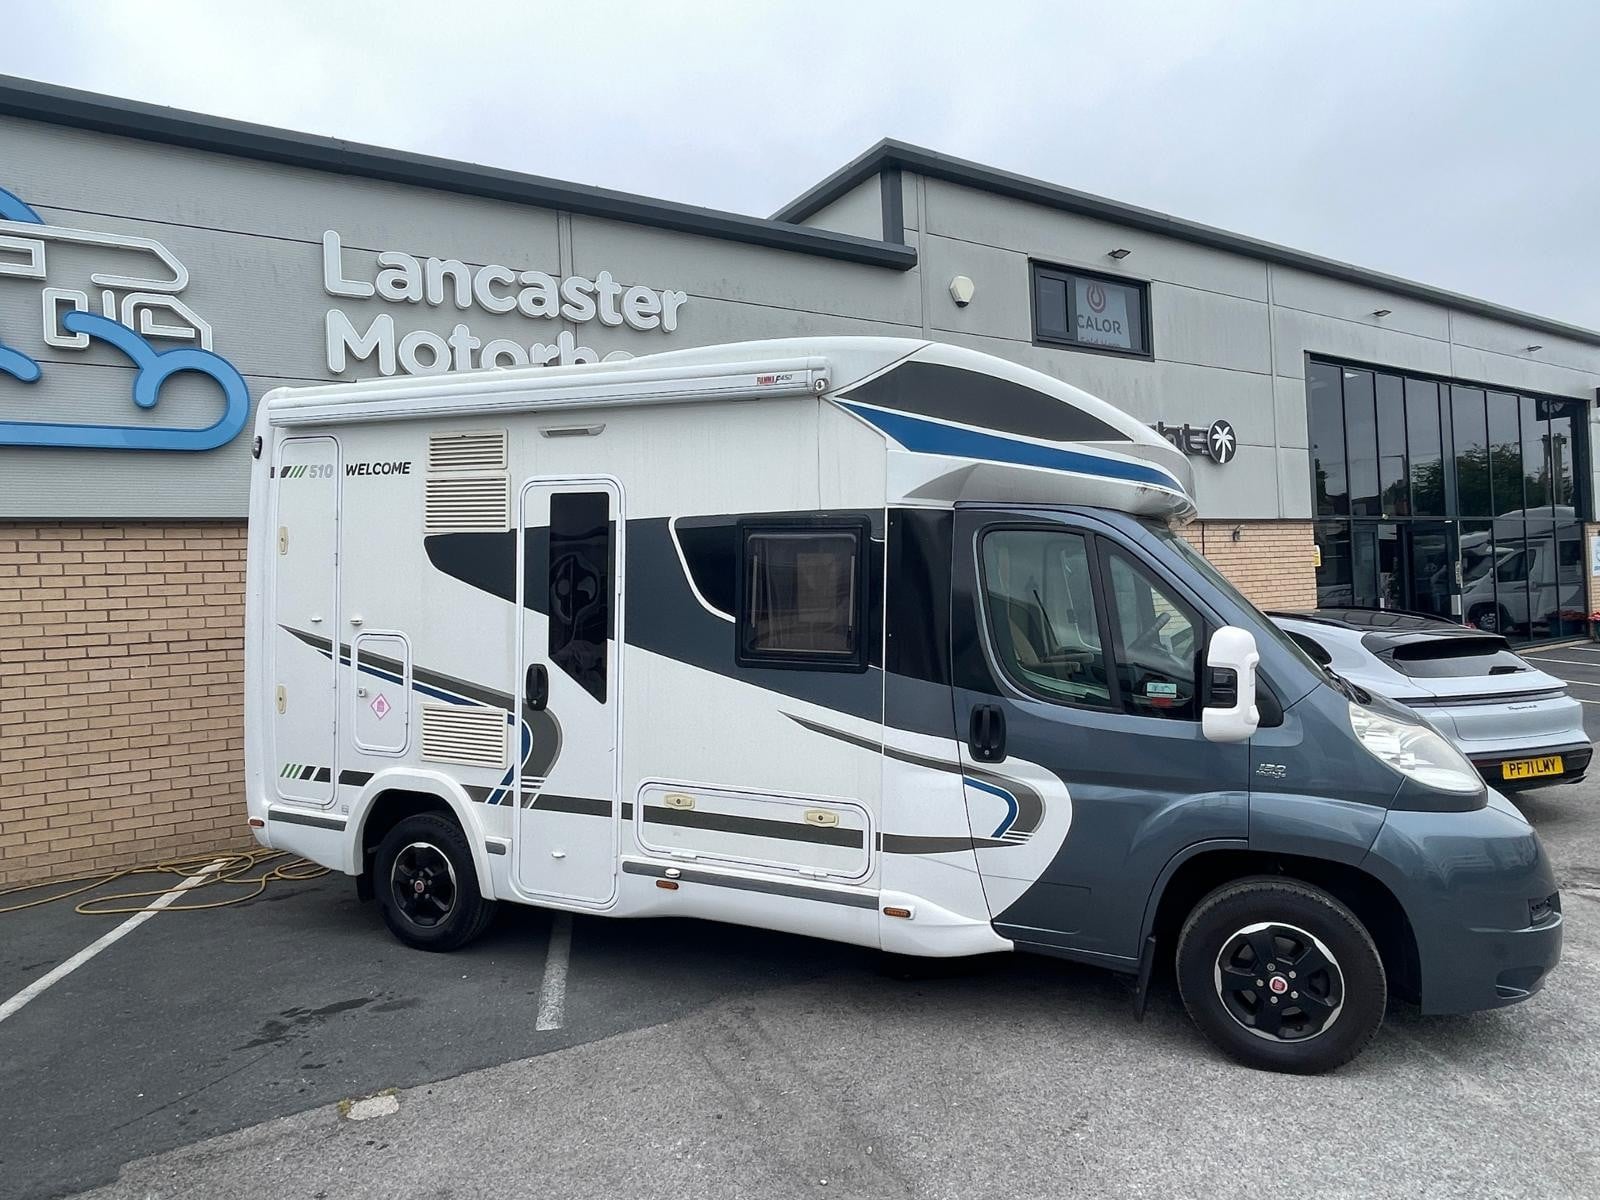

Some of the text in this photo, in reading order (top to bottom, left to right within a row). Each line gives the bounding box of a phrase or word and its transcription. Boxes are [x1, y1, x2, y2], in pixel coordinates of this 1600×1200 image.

[323, 229, 688, 333] Lancaster
[1077, 314, 1122, 335] CALOR
[325, 309, 637, 376] Motorh
[308, 461, 411, 479] 510 WELCOME
[1509, 758, 1556, 776] PF71 LMY
